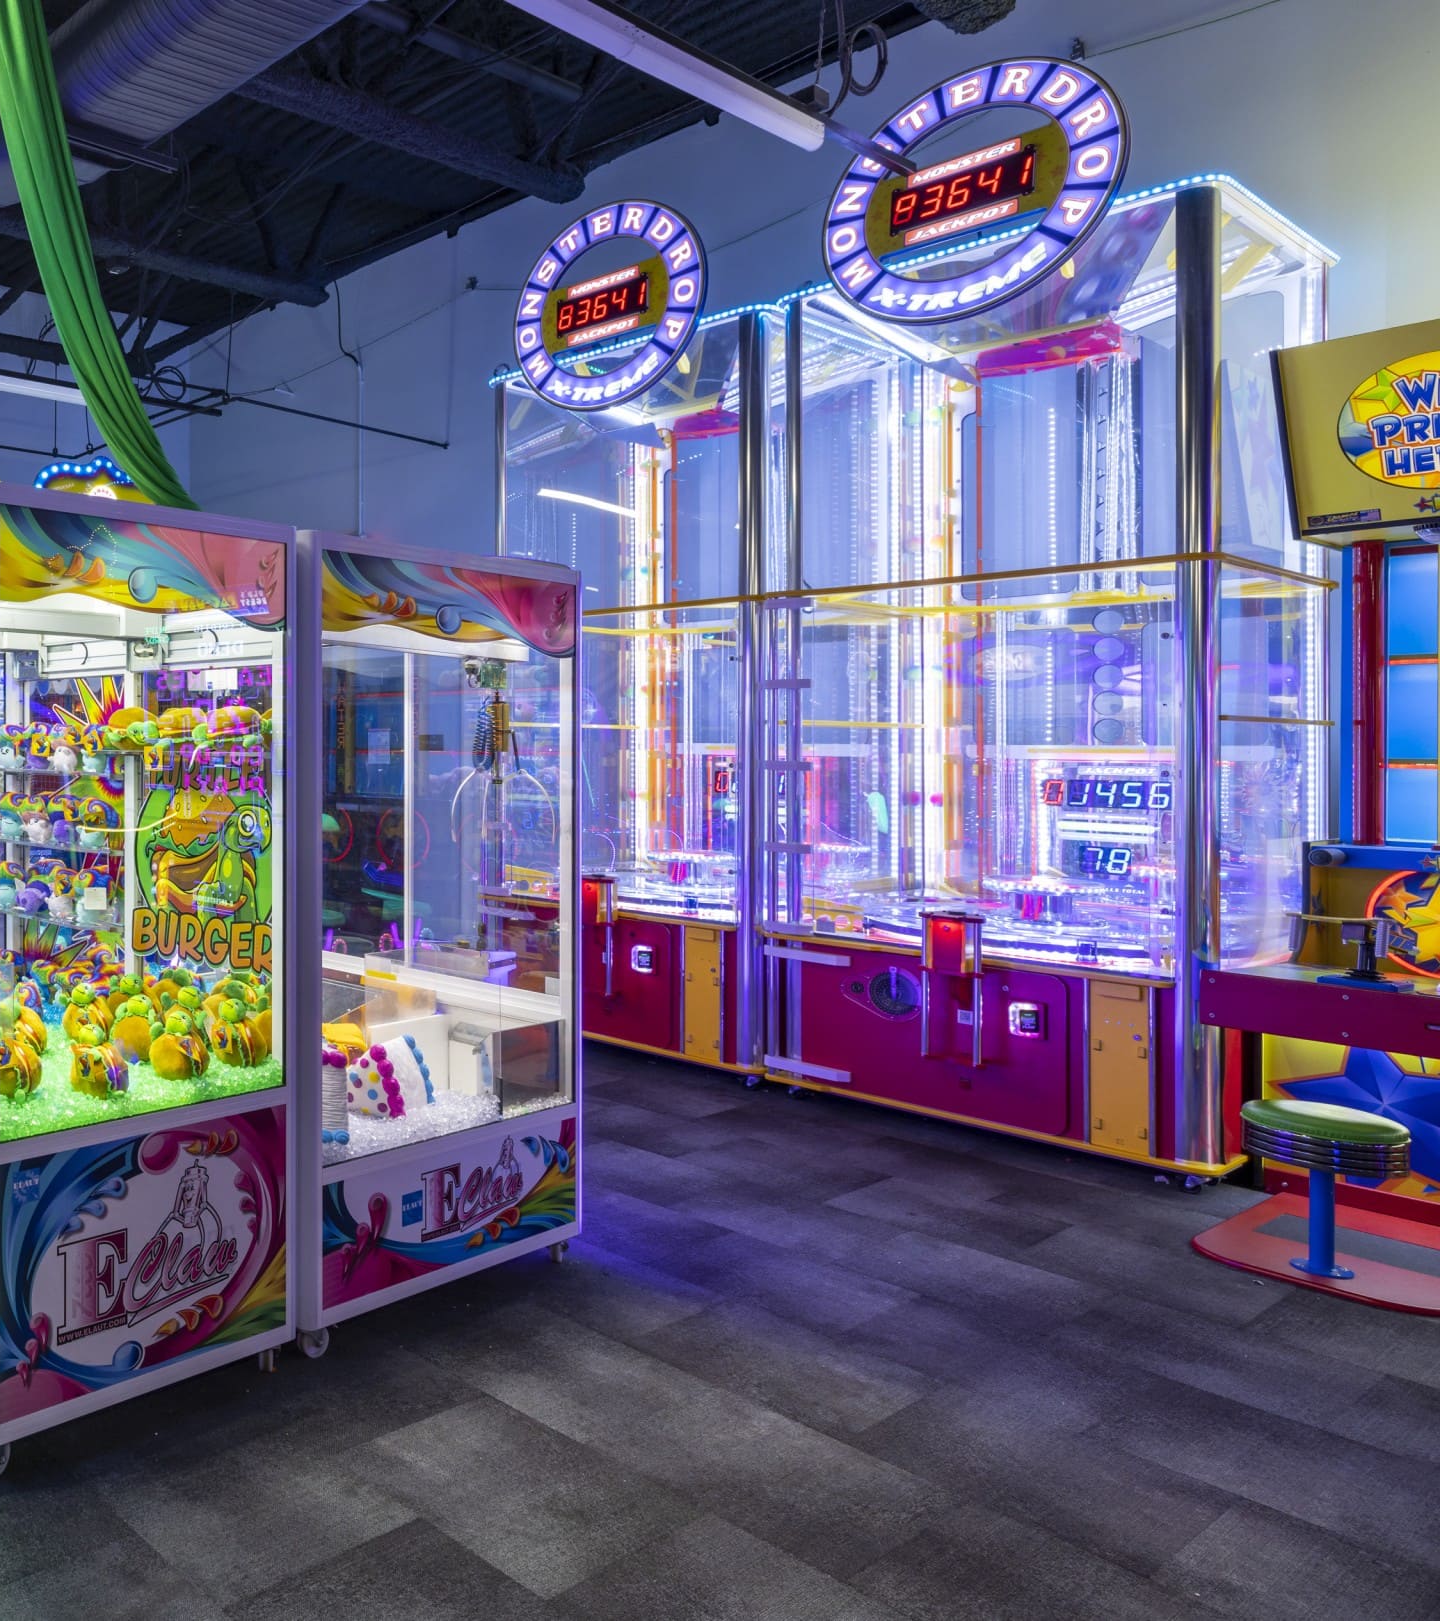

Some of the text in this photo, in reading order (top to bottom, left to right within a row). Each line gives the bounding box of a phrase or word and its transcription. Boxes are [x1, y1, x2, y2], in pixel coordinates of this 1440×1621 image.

[913, 141, 1016, 183] MONSTER
[909, 202, 1013, 242] JACKPOT
[570, 268, 636, 296] MONSTER
[869, 241, 1048, 312] X-TREME
[558, 282, 647, 331] 83641
[571, 319, 635, 344] JACKPOT
[547, 352, 660, 401] X-TREME
[1083, 766, 1157, 776] JACKPOT
[1086, 847, 1131, 875] 78
[133, 907, 272, 975] BURGER
[57, 1317, 127, 1345] WWW.ELAUT.COM
